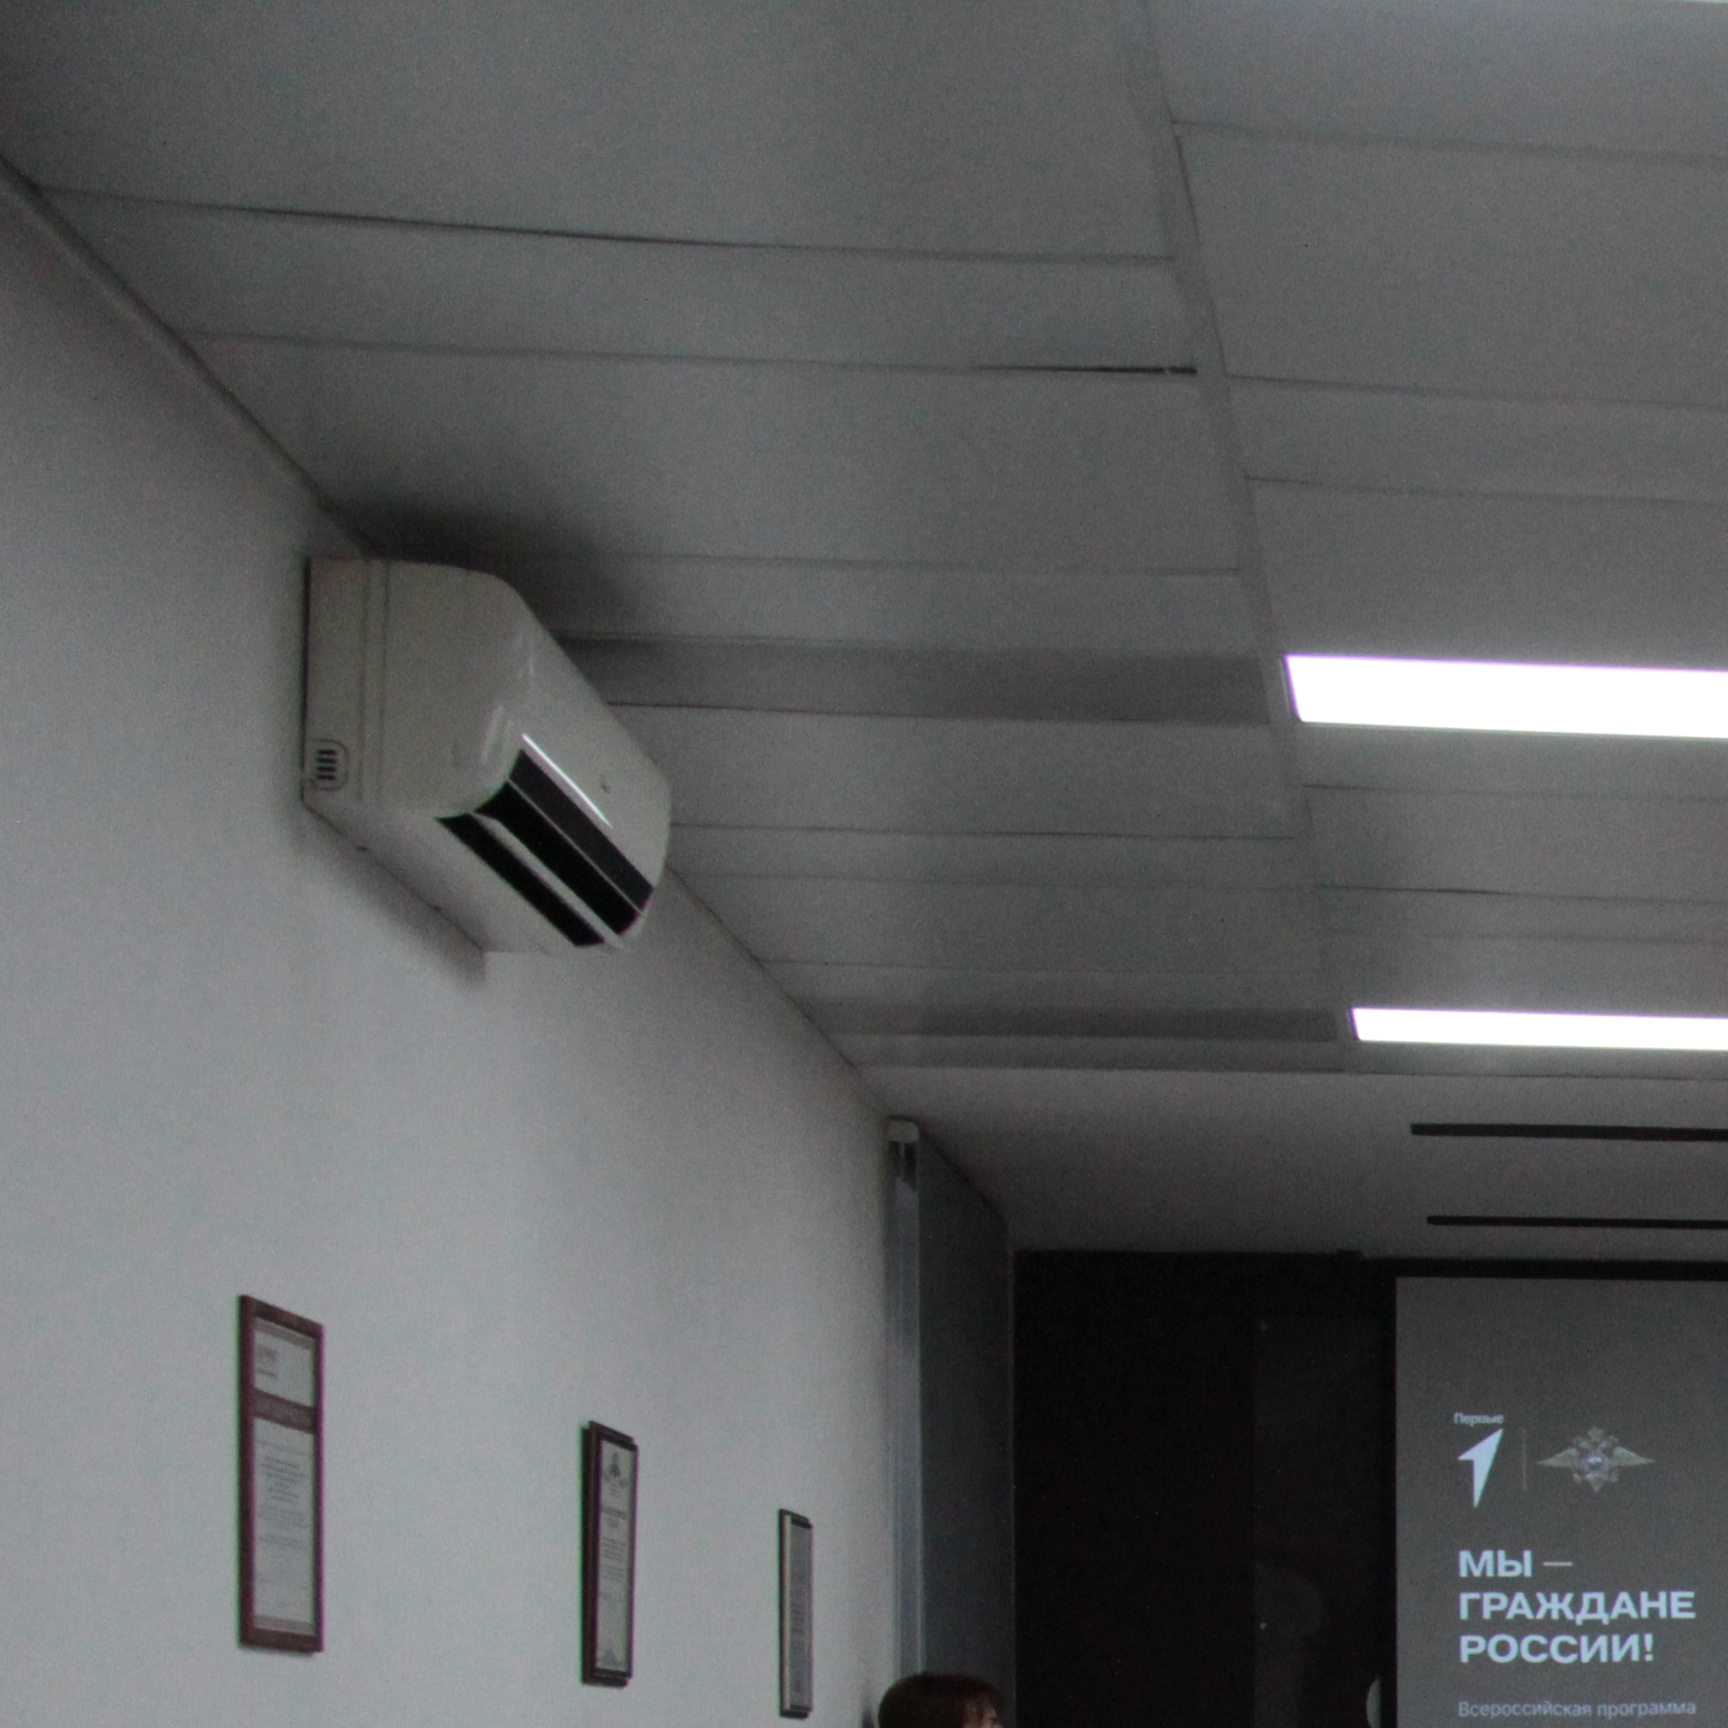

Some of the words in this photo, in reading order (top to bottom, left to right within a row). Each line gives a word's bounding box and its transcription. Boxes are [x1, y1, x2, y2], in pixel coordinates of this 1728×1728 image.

[1458, 1549, 1533, 1579] МЫ
[1459, 1590, 1696, 1626] ГРАЖДАНЕ
[1459, 1632, 1654, 1665] РОССИИ!
[1457, 1698, 1592, 1719] Всероссийская
[1596, 1700, 1696, 1721] программа
